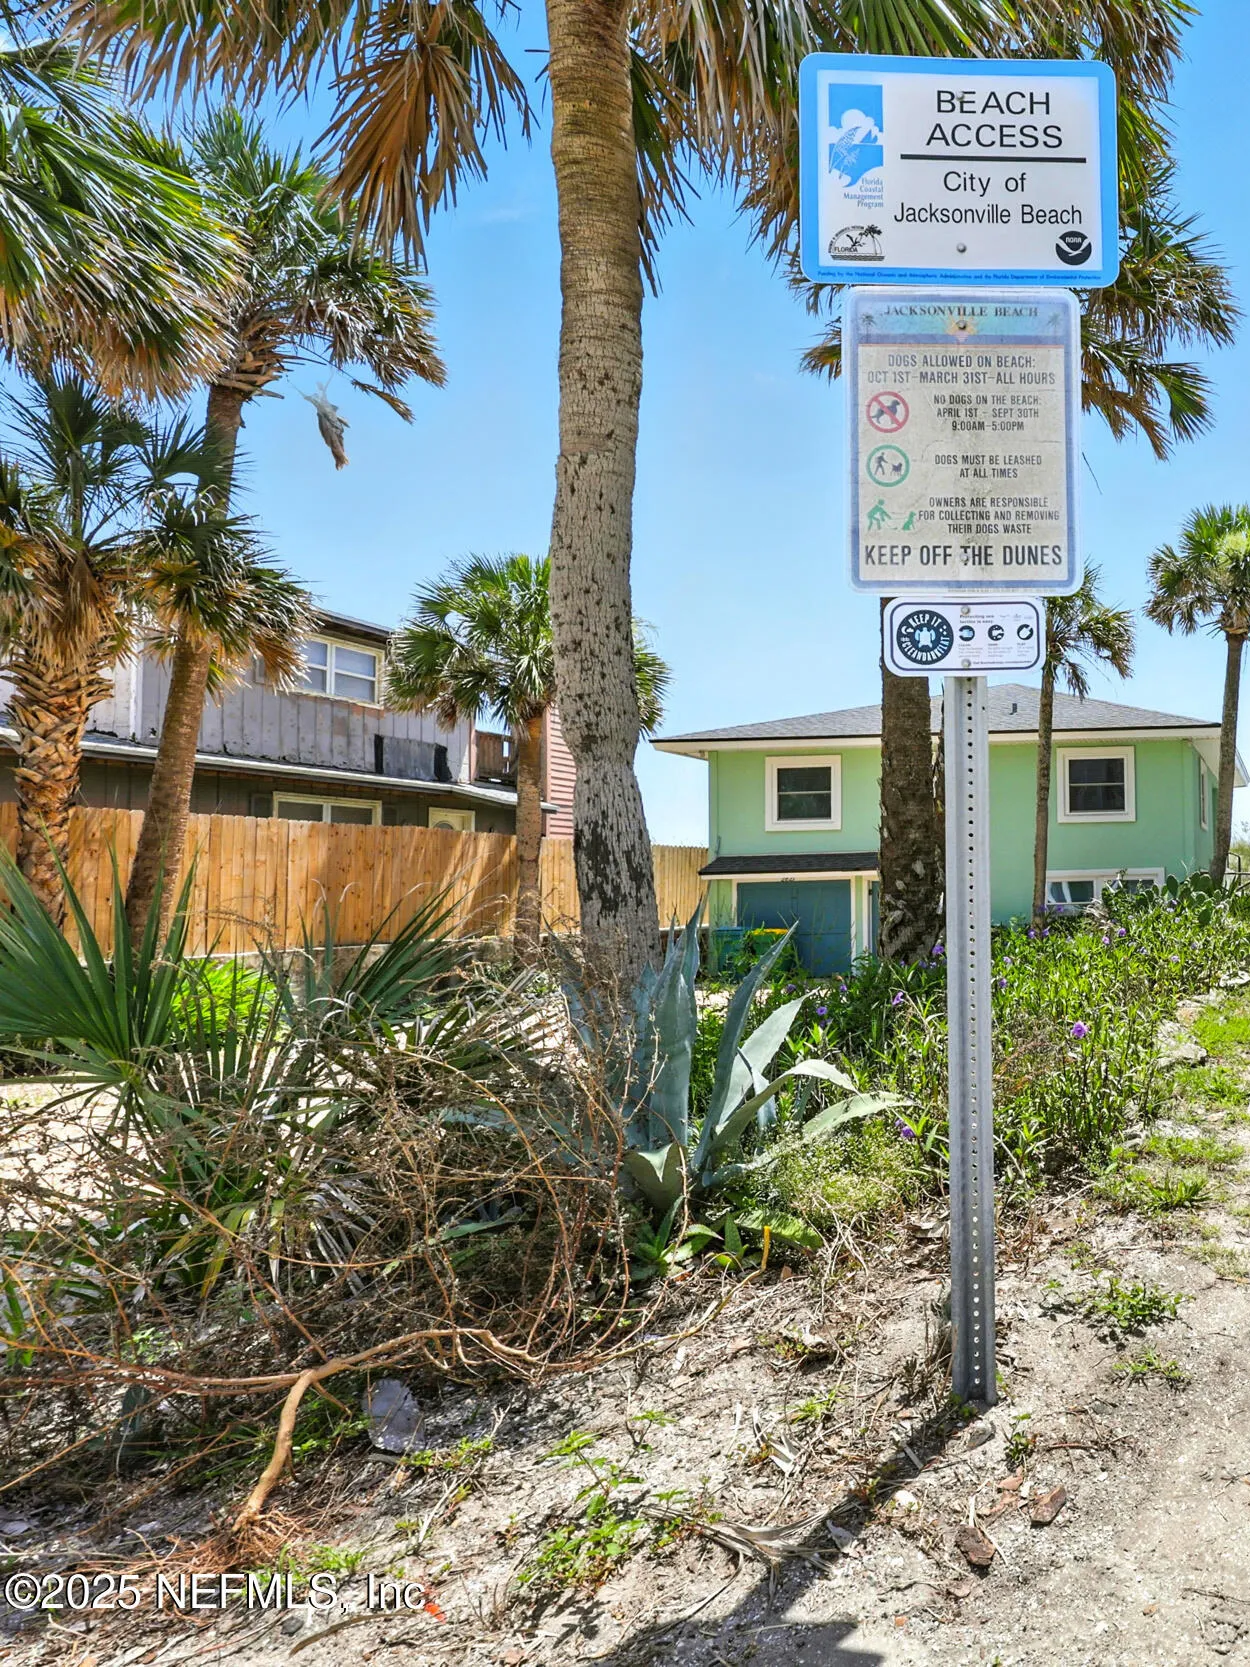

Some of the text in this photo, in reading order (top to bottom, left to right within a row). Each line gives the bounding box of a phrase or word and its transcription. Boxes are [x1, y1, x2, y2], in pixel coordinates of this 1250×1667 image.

[937, 90, 1050, 115] BEACH
[926, 123, 1063, 149] ACCESS
[944, 170, 1026, 197] City of
[894, 202, 1082, 224] Jacksonville Beach
[885, 305, 1038, 317] JACKSONVILLE BEACH
[888, 355, 1036, 367] DOGS ALLOWED ON BEACH:
[868, 371, 887, 383] OCT
[1020, 372, 1055, 384] HOURS
[934, 395, 946, 405] NO
[949, 395, 972, 405] DOGS
[976, 395, 988, 405] ON
[992, 395, 1006, 405] THE
[937, 408, 960, 417] APRIL
[964, 408, 978, 417] 1ST
[992, 408, 1013, 417] SEPT
[1017, 408, 1039, 417] 30TH
[935, 455, 1042, 465] DOGS MUST BE LEASHED
[960, 468, 1018, 478] AT ALL TIMES
[929, 498, 1048, 507] OWNERS ARE RESPONSIBLE
[919, 511, 1060, 521] FOR COLLECTING AND REMOVING
[948, 524, 1031, 534] THEIR DOGS WASTE
[865, 545, 1062, 566] KEEP OFF THE DUNES
[908, 614, 942, 627] KEEP IT
